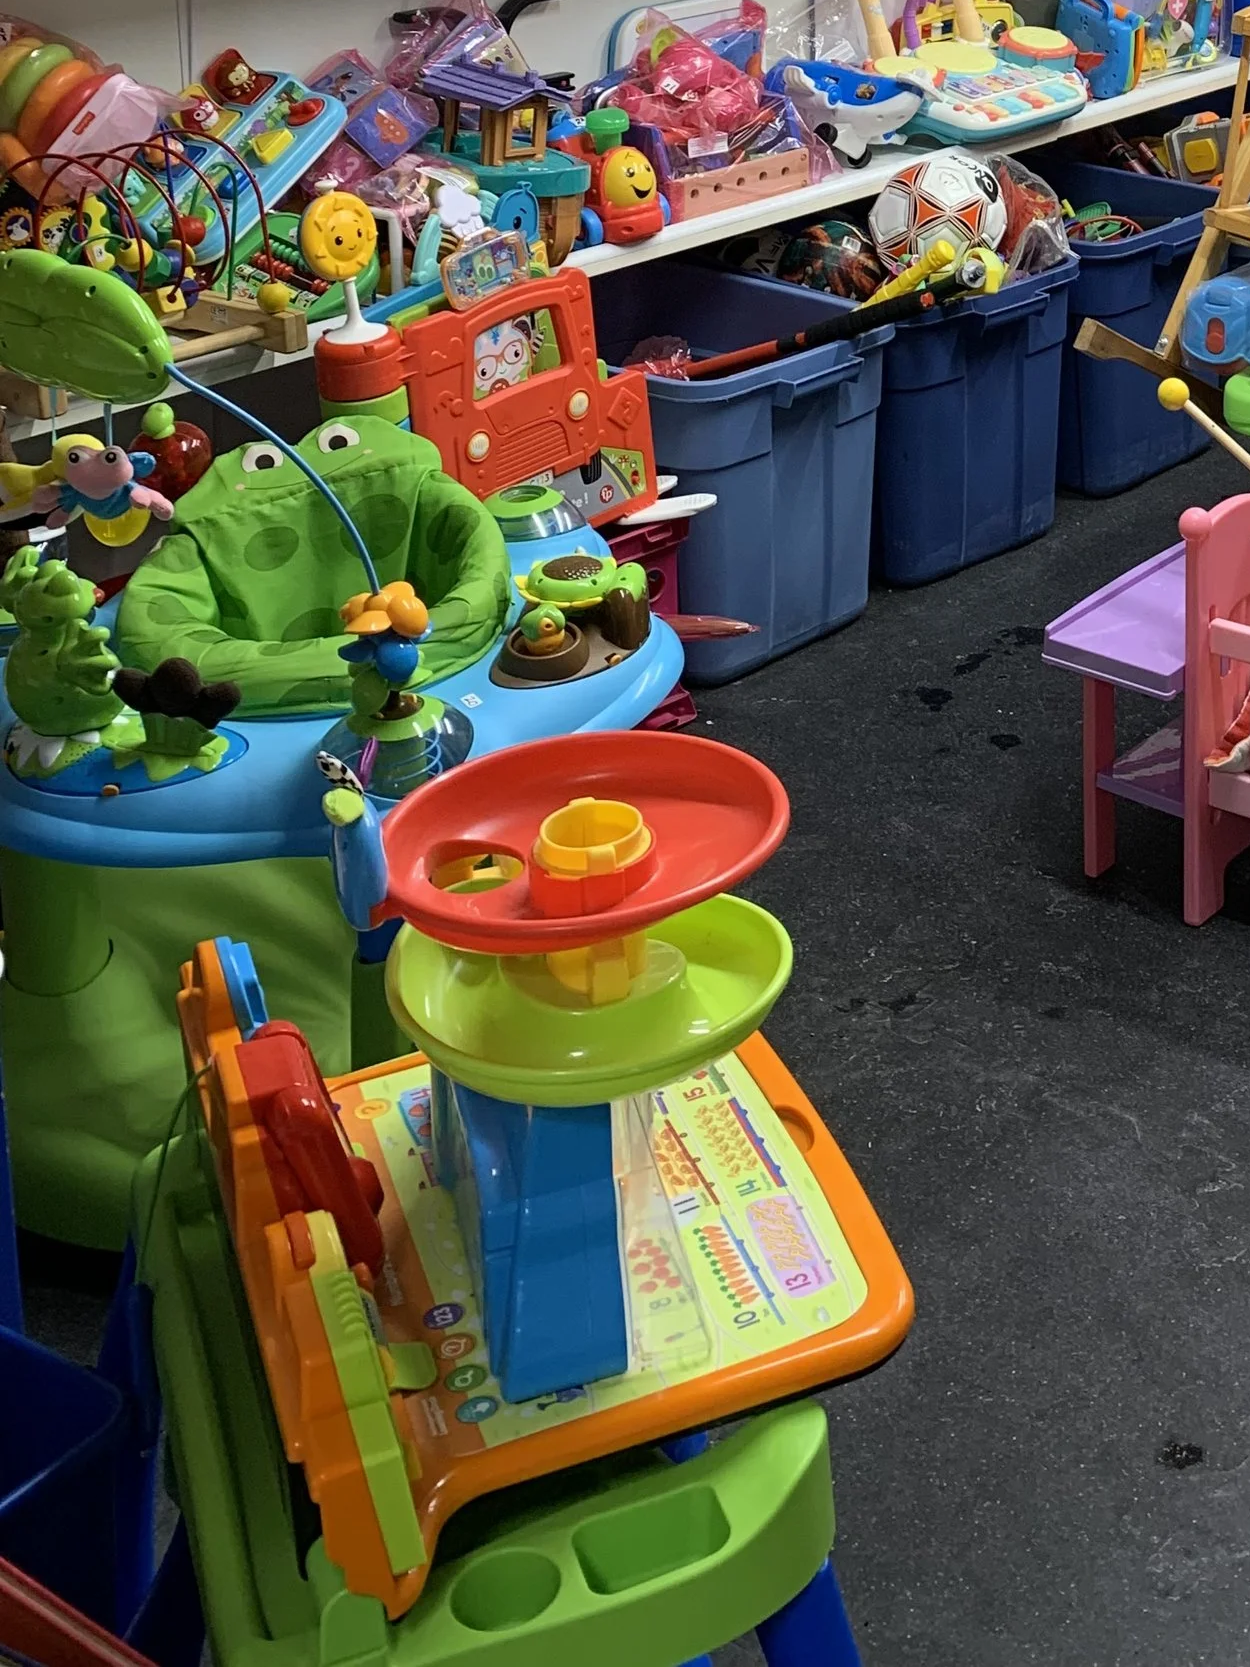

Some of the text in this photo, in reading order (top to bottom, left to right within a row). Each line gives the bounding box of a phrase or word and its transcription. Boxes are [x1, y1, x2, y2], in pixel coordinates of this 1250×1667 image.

[683, 1086, 708, 1103] 15
[735, 1178, 762, 1198] 14
[673, 1196, 701, 1216] 11
[785, 1272, 812, 1292] 13
[435, 1305, 452, 1326] 123
[733, 1310, 761, 1330] 10
